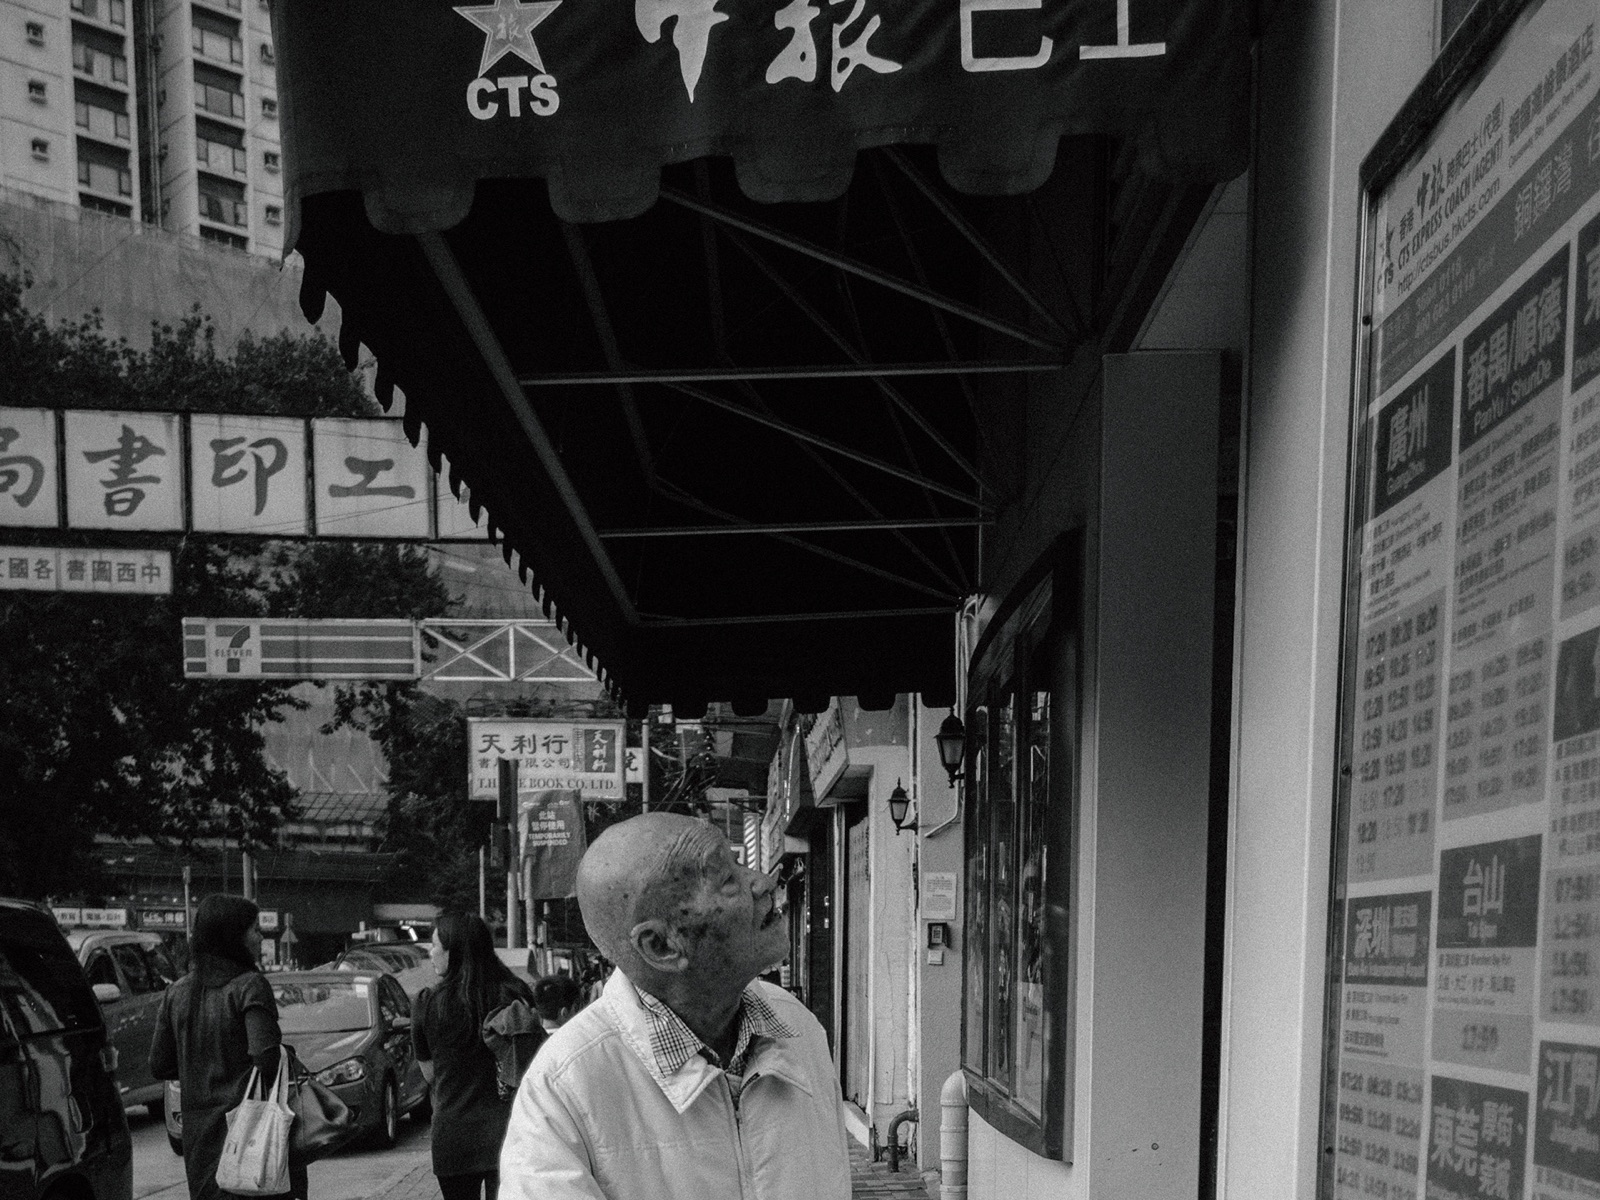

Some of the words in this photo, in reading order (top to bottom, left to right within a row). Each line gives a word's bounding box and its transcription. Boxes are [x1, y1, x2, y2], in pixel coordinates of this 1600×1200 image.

[466, 74, 560, 120] CTS
[1399, 242, 1410, 270] CTS
[1412, 203, 1442, 258] EXPRESS
[1445, 173, 1471, 220] COACH
[1468, 277, 1562, 408] 番禺/順德
[1386, 383, 1428, 471] 廣州
[215, 625, 251, 673] 7
[478, 733, 569, 755] 天利行
[479, 758, 571, 769] 書限公司
[529, 777, 564, 789] BOOK
[590, 779, 617, 790] LTD.
[1462, 854, 1505, 916] 台山
[1354, 906, 1390, 959] 深圳
[1431, 1098, 1479, 1181] 東莞
